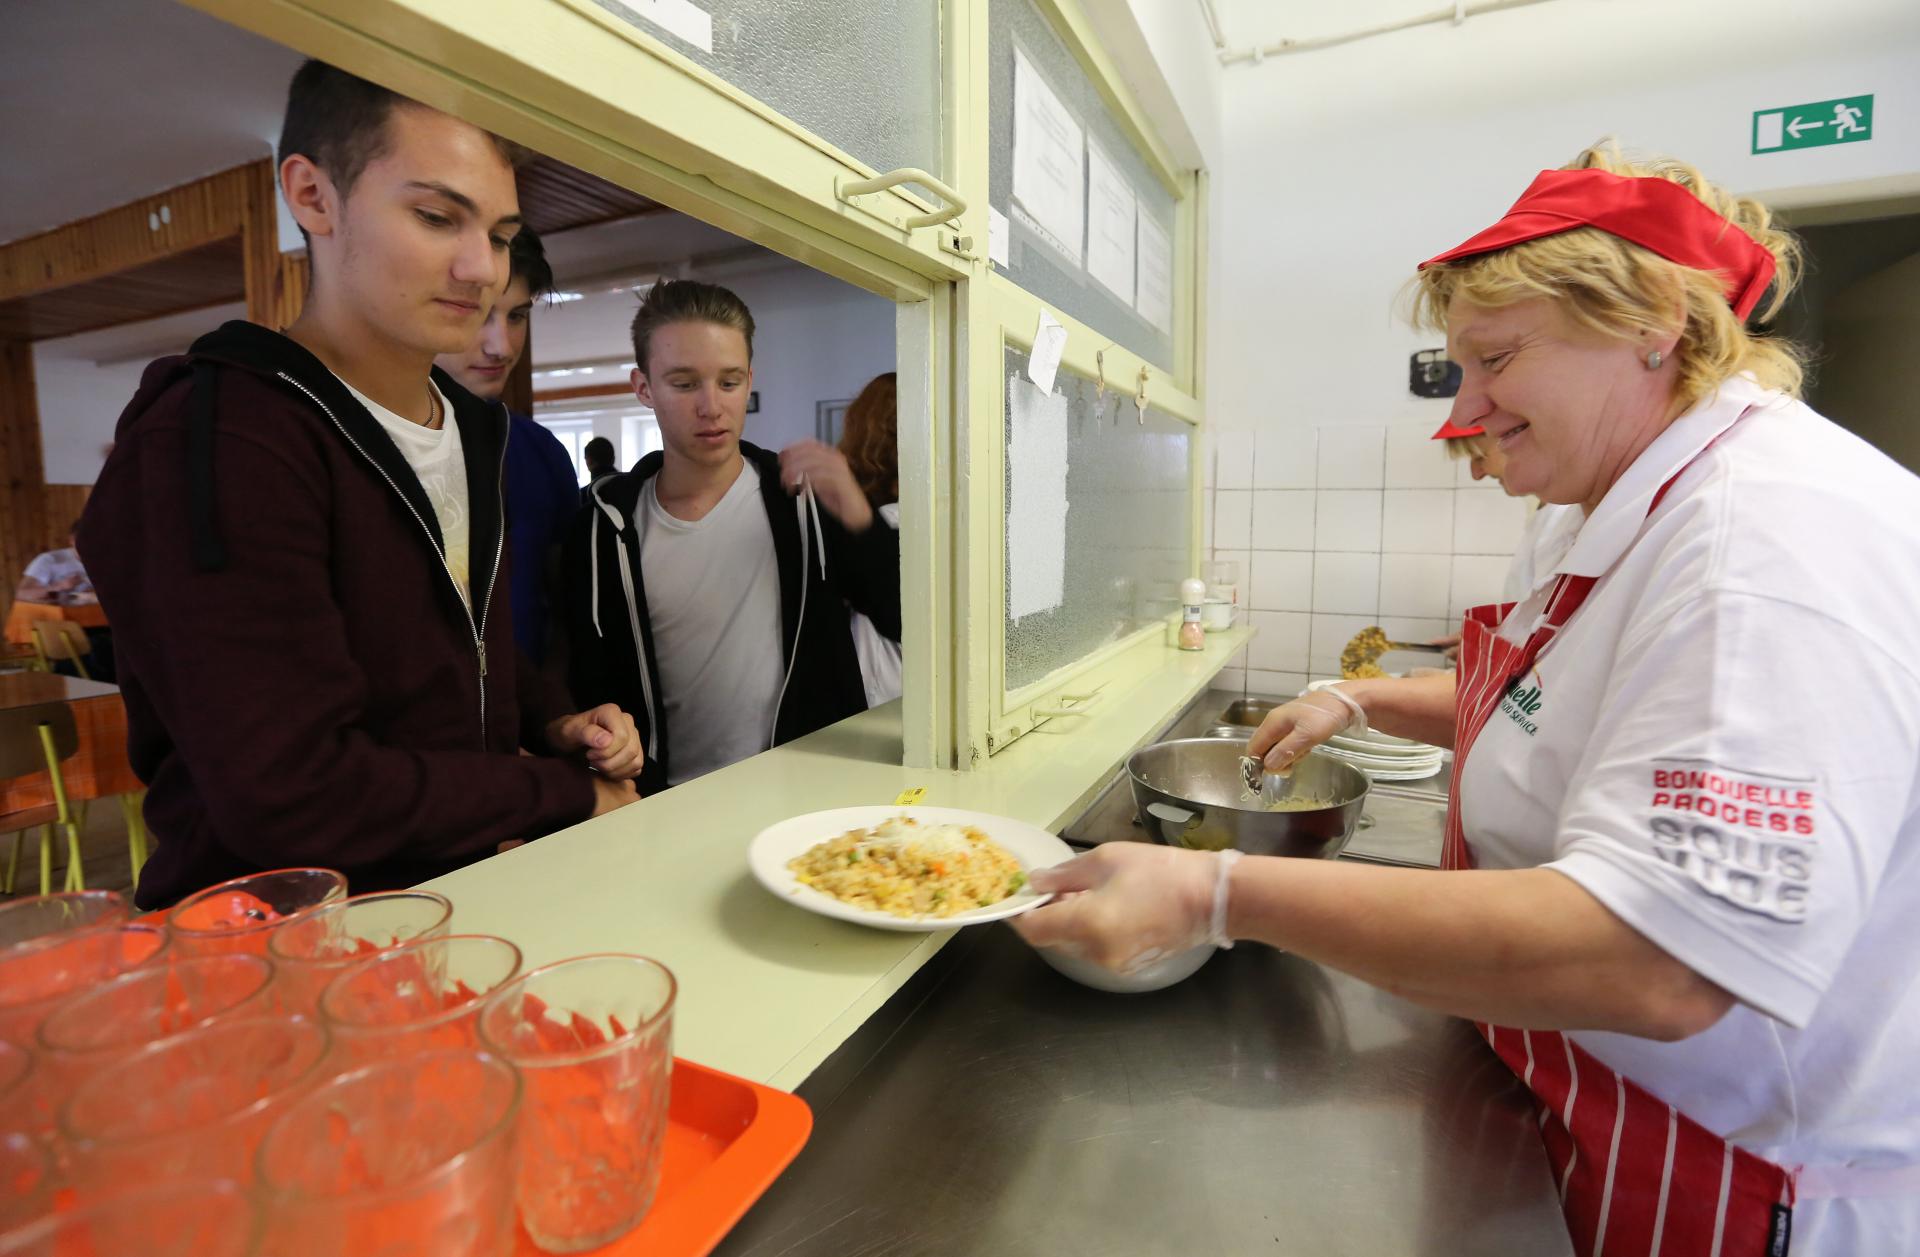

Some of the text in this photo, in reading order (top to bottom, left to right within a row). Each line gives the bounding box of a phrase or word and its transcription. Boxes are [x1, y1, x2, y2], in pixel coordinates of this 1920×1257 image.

[1653, 770, 1815, 810] BONDUELLE
[1652, 792, 1815, 835] PROCESS
[1649, 816, 1811, 881] SOUS
